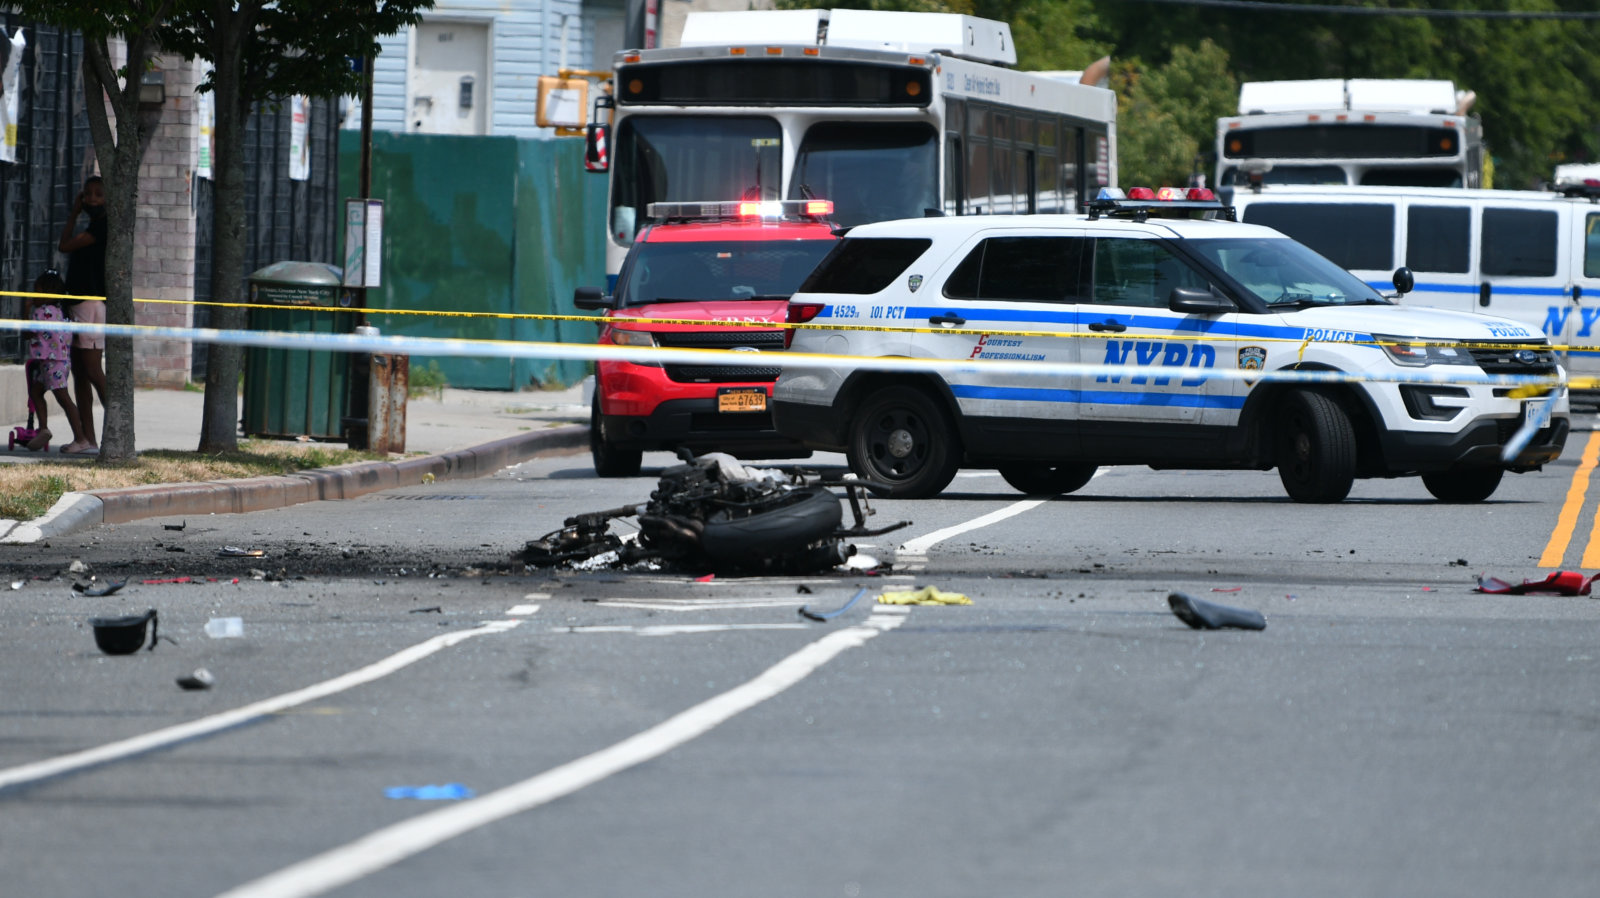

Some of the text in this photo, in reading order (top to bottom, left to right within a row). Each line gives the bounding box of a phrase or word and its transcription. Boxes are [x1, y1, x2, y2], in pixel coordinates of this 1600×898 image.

[834, 305, 856, 318] 4529
[870, 306, 904, 319] 101 PCT
[1304, 328, 1353, 342] POLICE
[1488, 327, 1530, 337] POLICE
[978, 334, 1023, 347] COURTESY
[970, 346, 1046, 361] PROFESSIONALISM
[1095, 340, 1216, 387] NYPD
[744, 394, 763, 406] 7639
